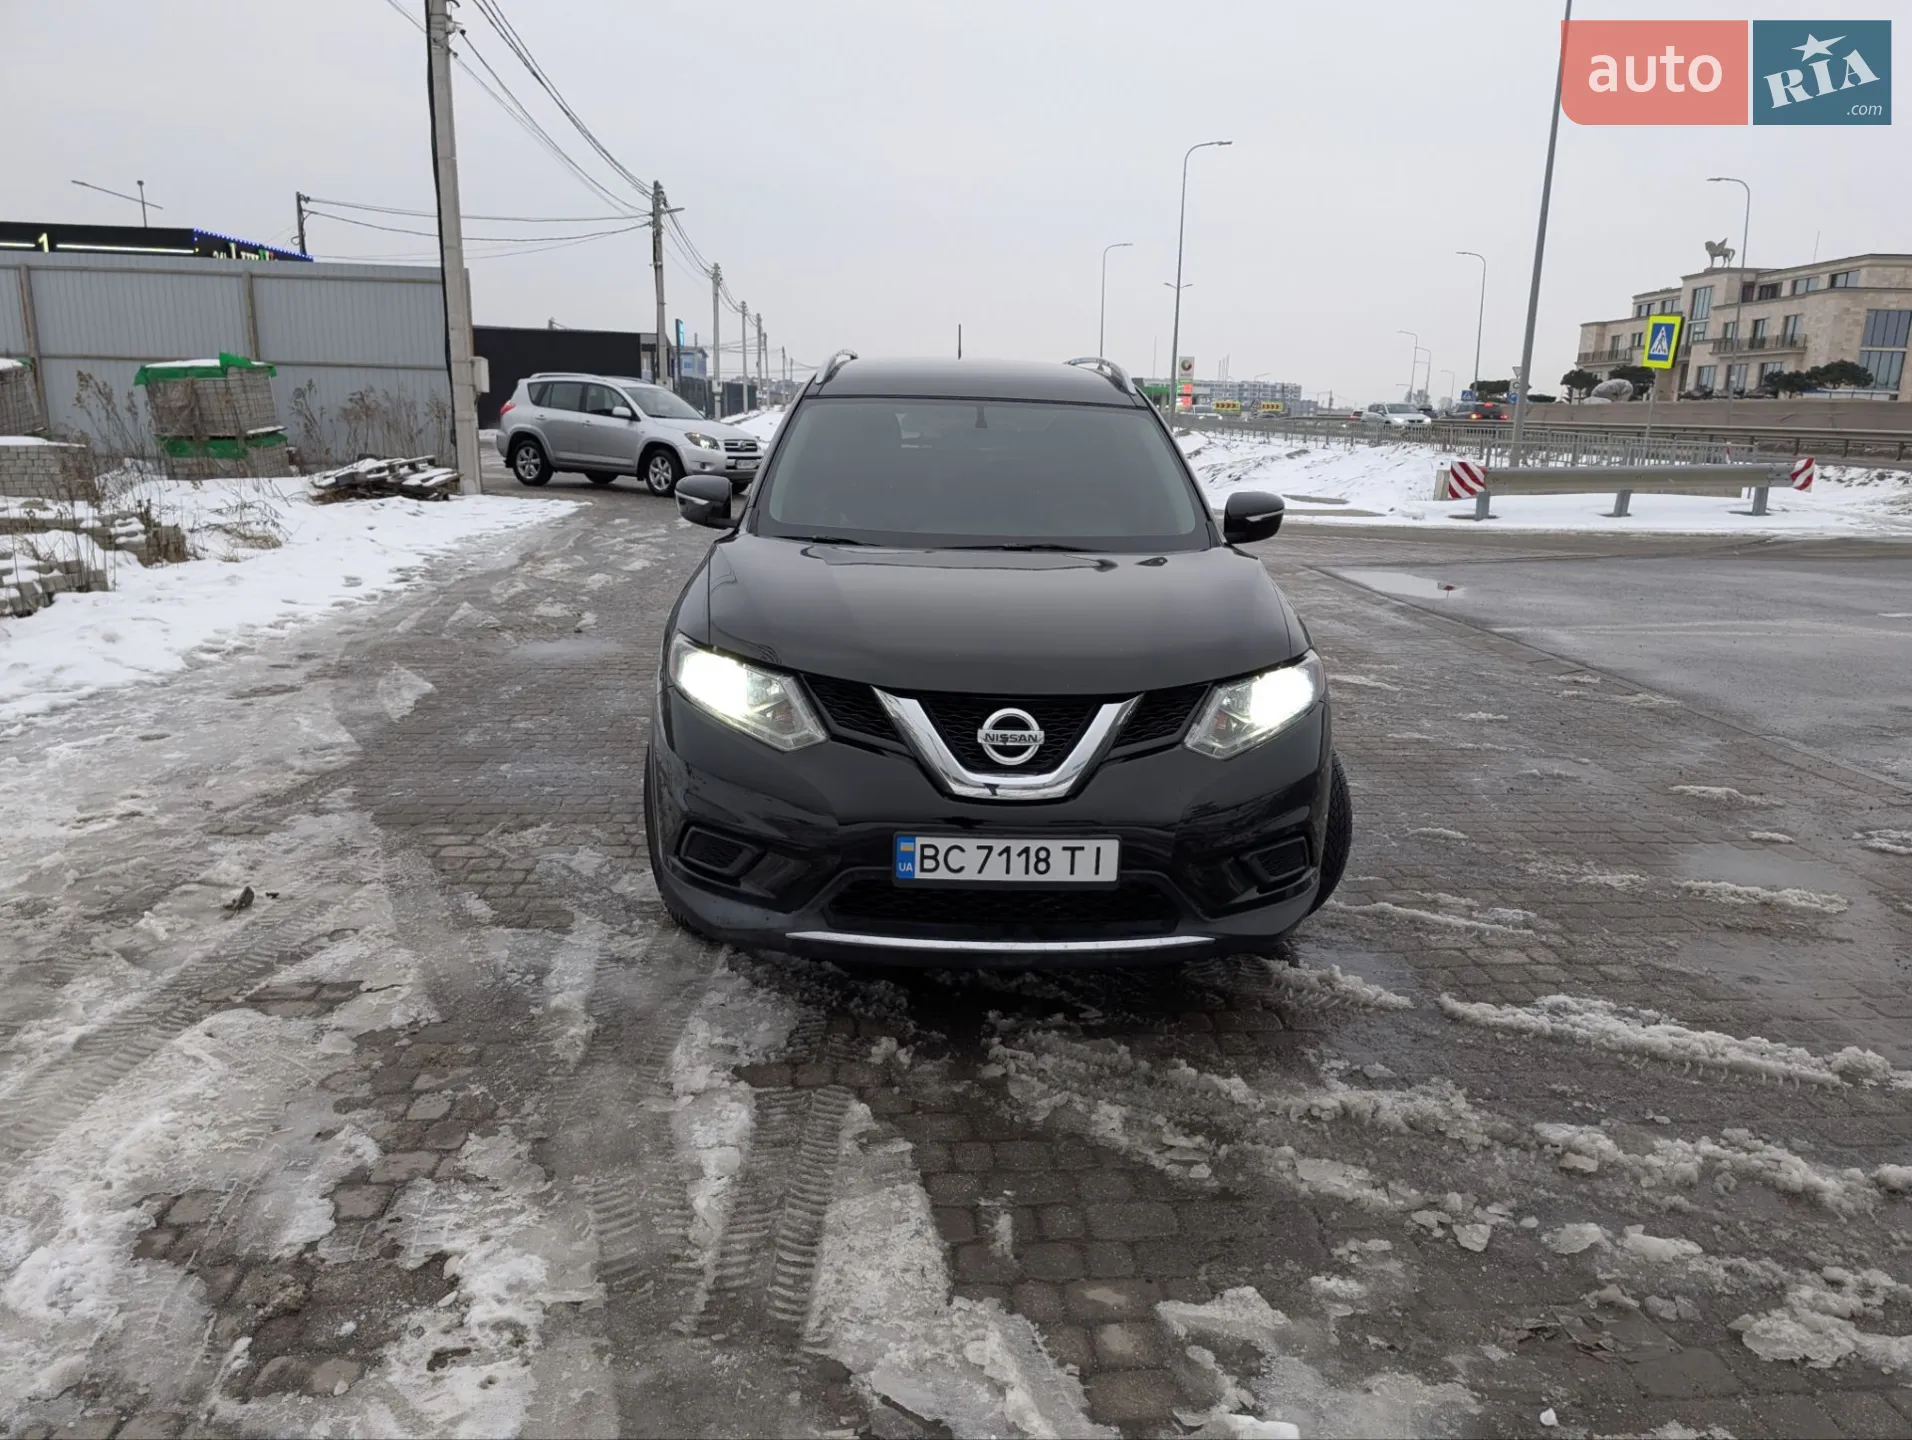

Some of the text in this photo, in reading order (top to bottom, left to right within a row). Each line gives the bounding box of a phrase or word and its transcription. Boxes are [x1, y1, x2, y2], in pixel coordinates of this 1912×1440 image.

[984, 732, 1038, 743] NISSAN
[976, 845, 1051, 875] 7118
[898, 862, 914, 873] UA
